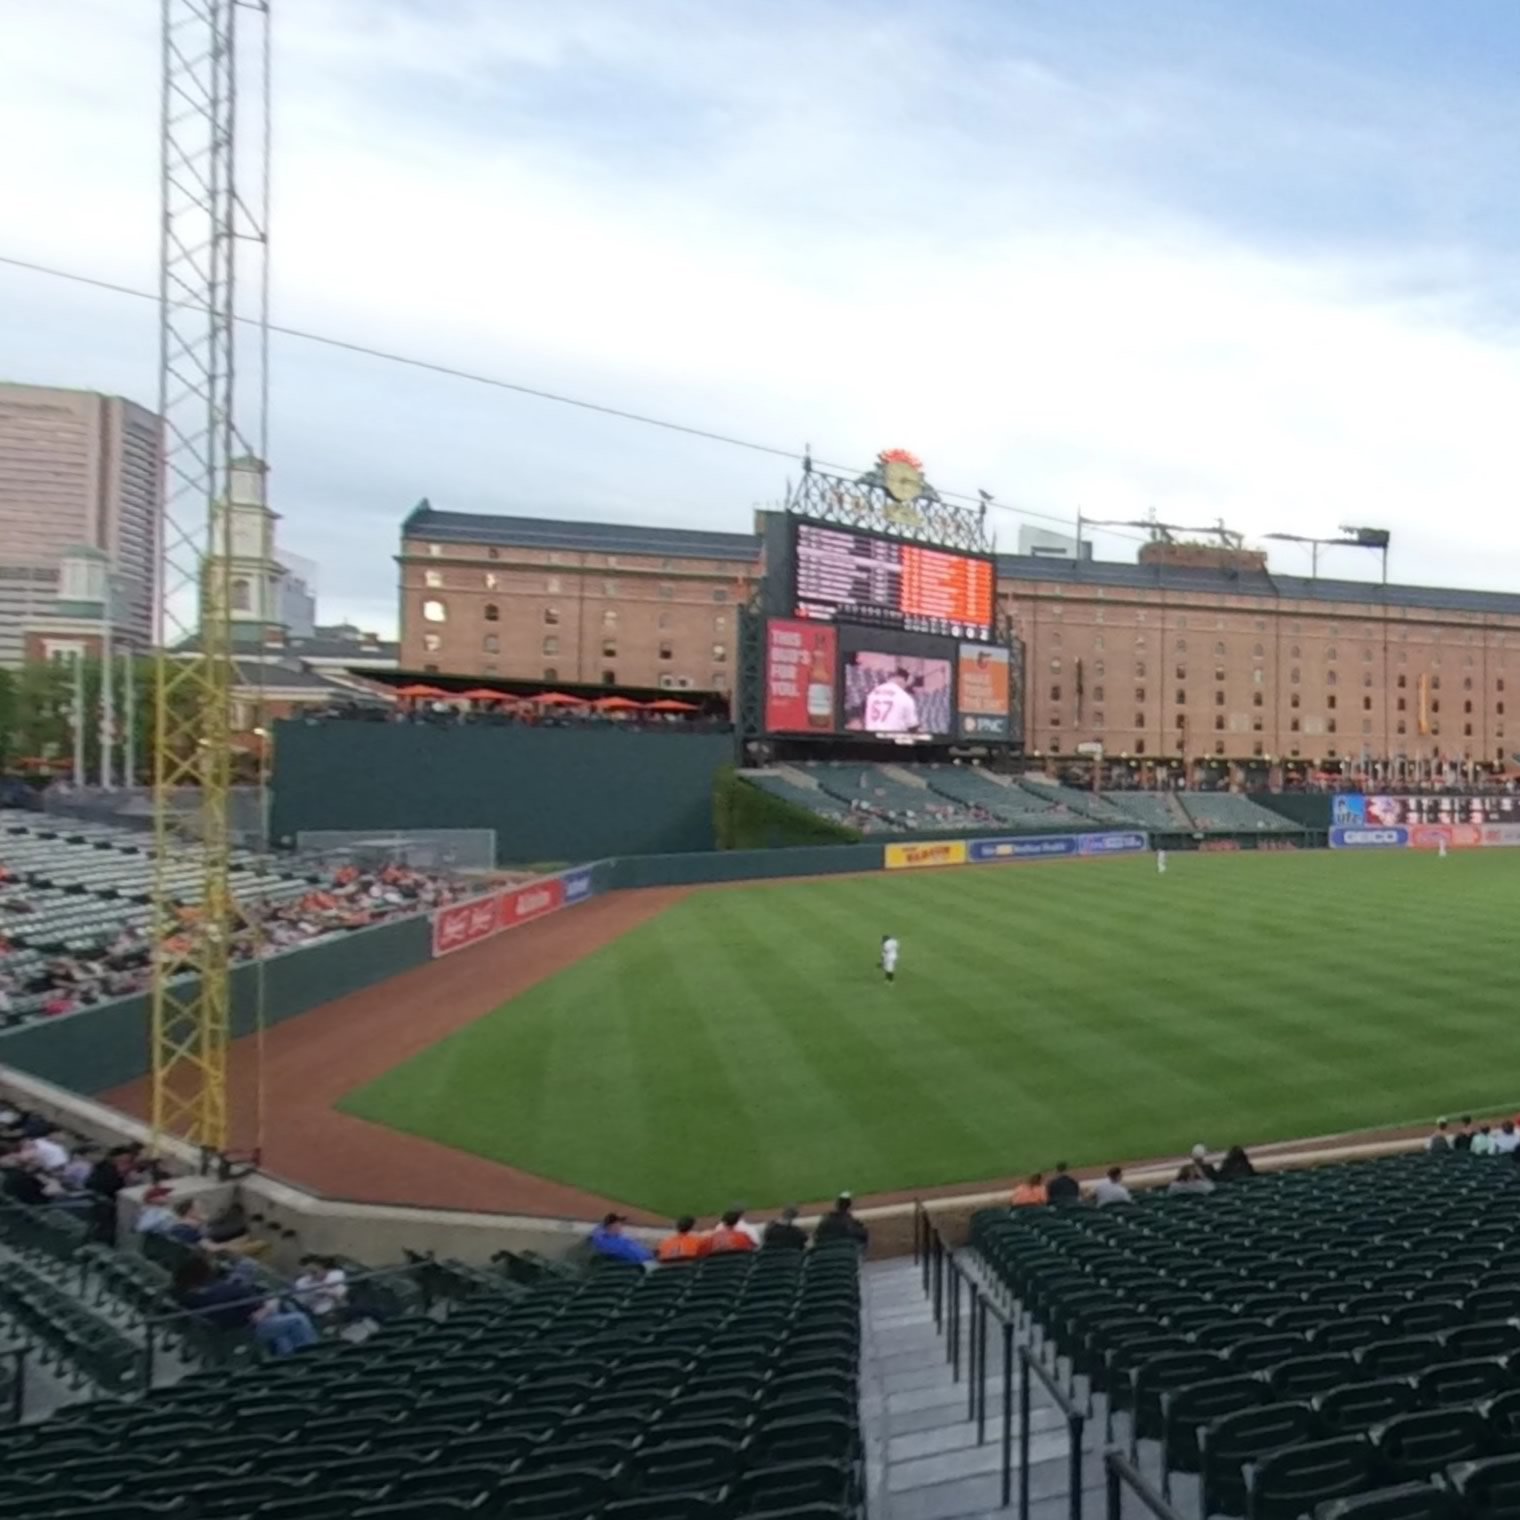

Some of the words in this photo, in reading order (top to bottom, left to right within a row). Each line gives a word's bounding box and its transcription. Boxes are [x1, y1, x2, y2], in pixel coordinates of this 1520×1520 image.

[770, 629, 802, 647] THIS
[770, 663, 798, 679] FOR
[976, 717, 1004, 732] PNC
[1344, 829, 1398, 844] GEICO
